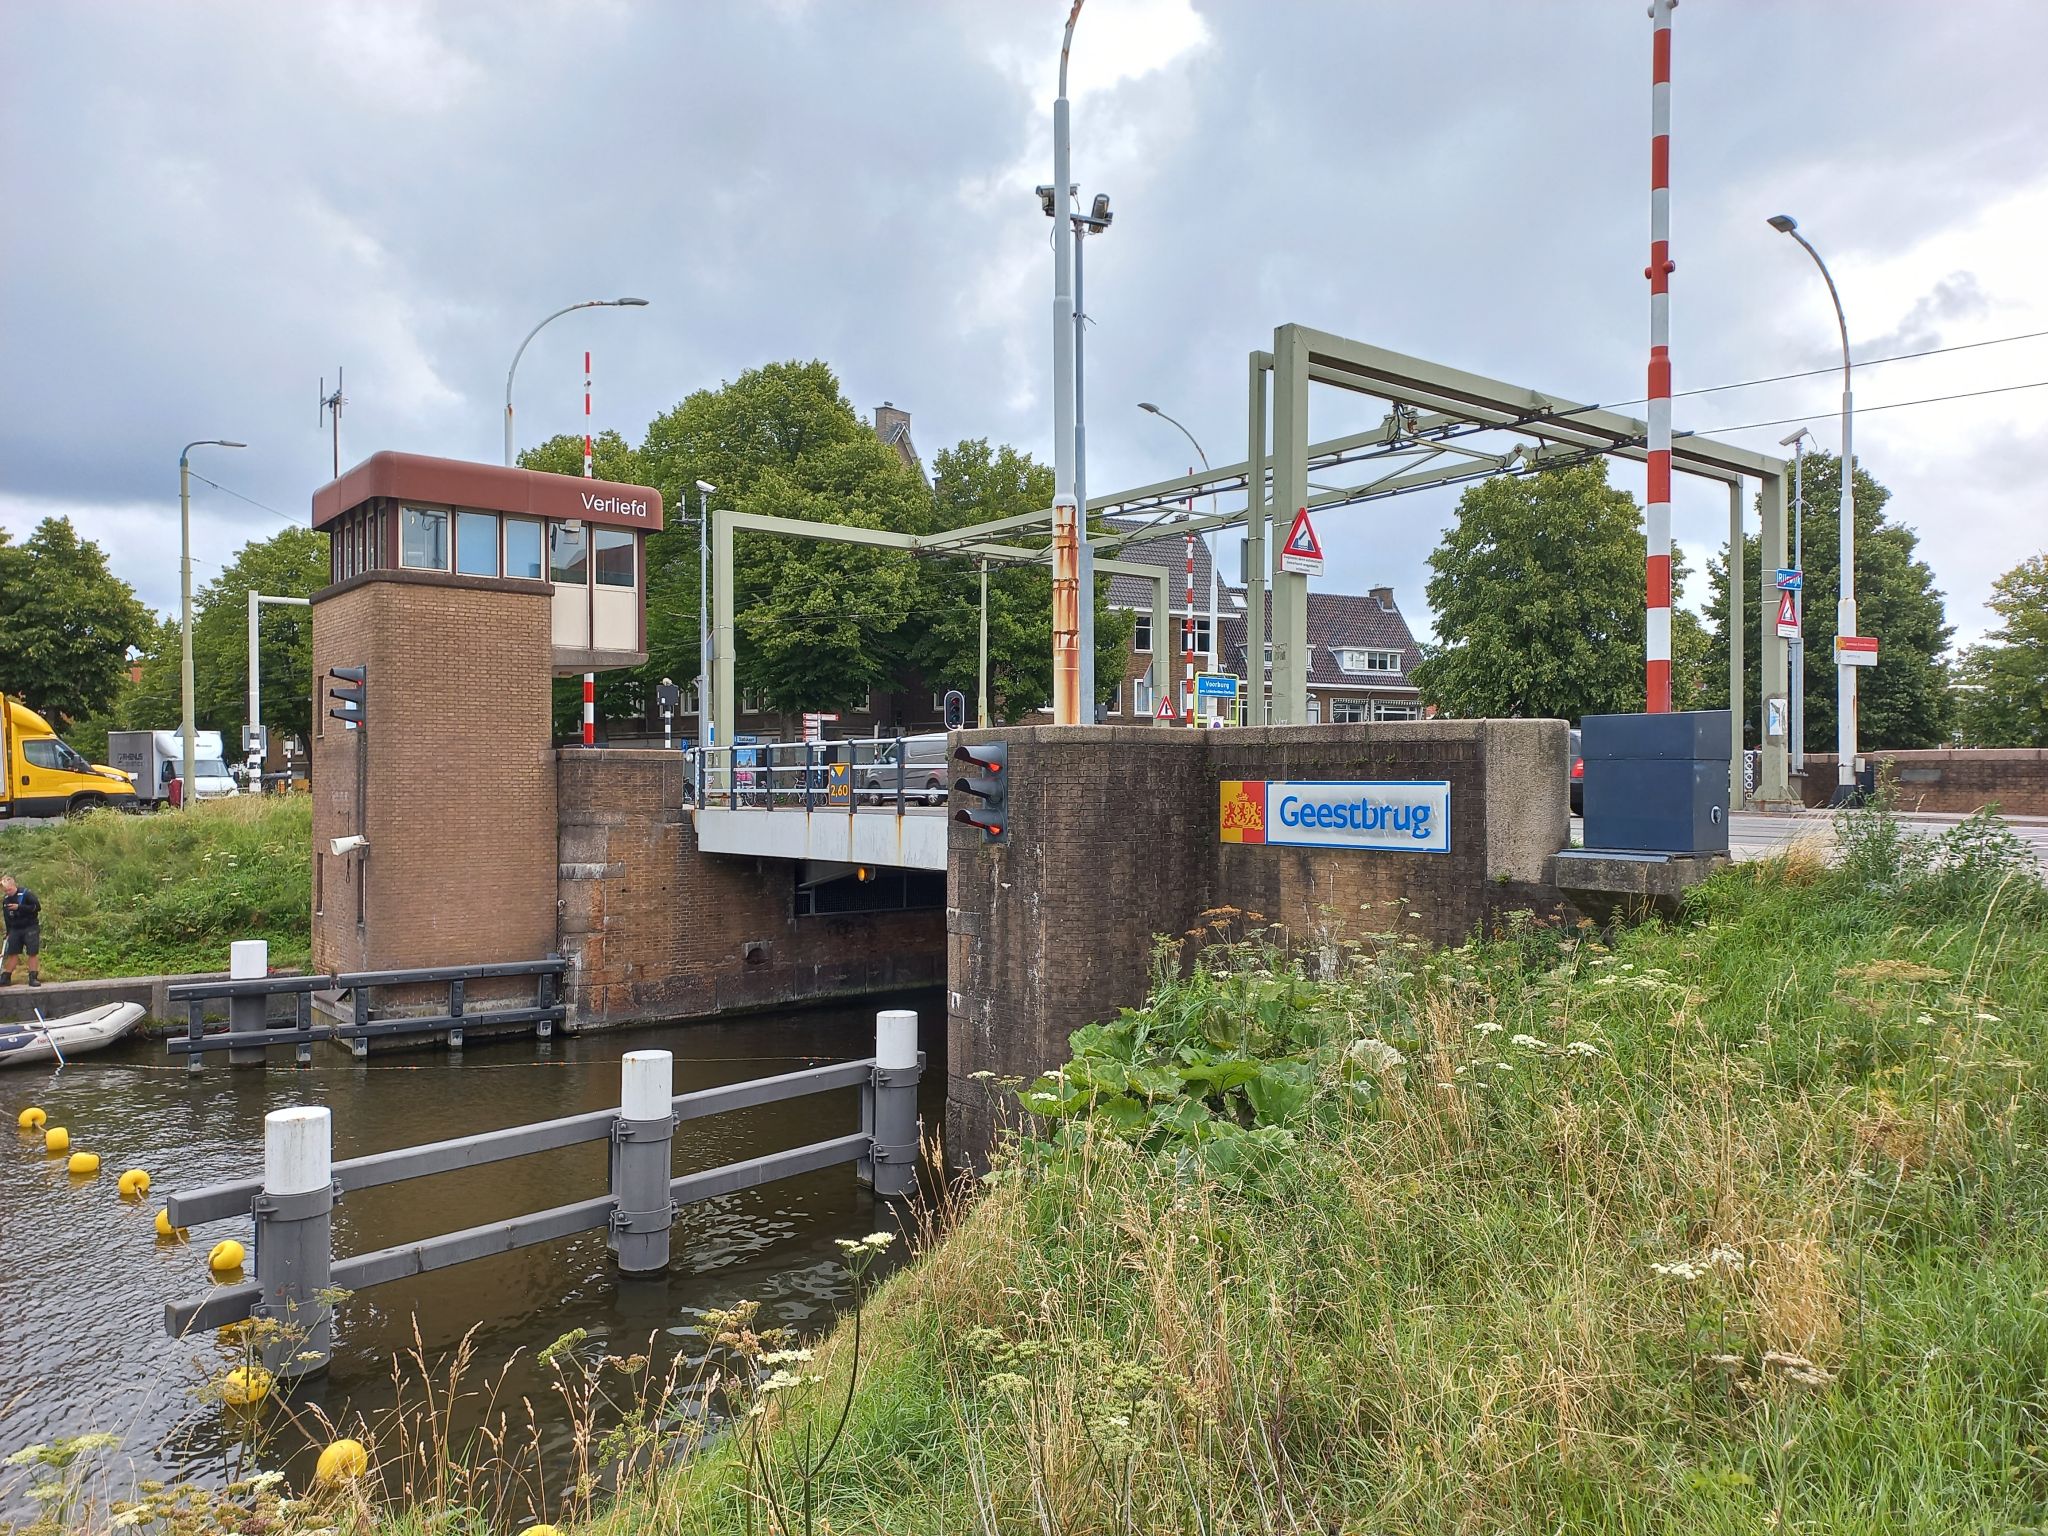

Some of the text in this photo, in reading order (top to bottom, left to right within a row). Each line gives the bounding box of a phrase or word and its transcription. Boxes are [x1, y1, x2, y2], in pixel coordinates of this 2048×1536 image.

[581, 492, 647, 518] Verliefd
[1205, 680, 1230, 690] Voorburg
[831, 784, 848, 798] 2,60
[1280, 795, 1432, 839] Geestbrug
